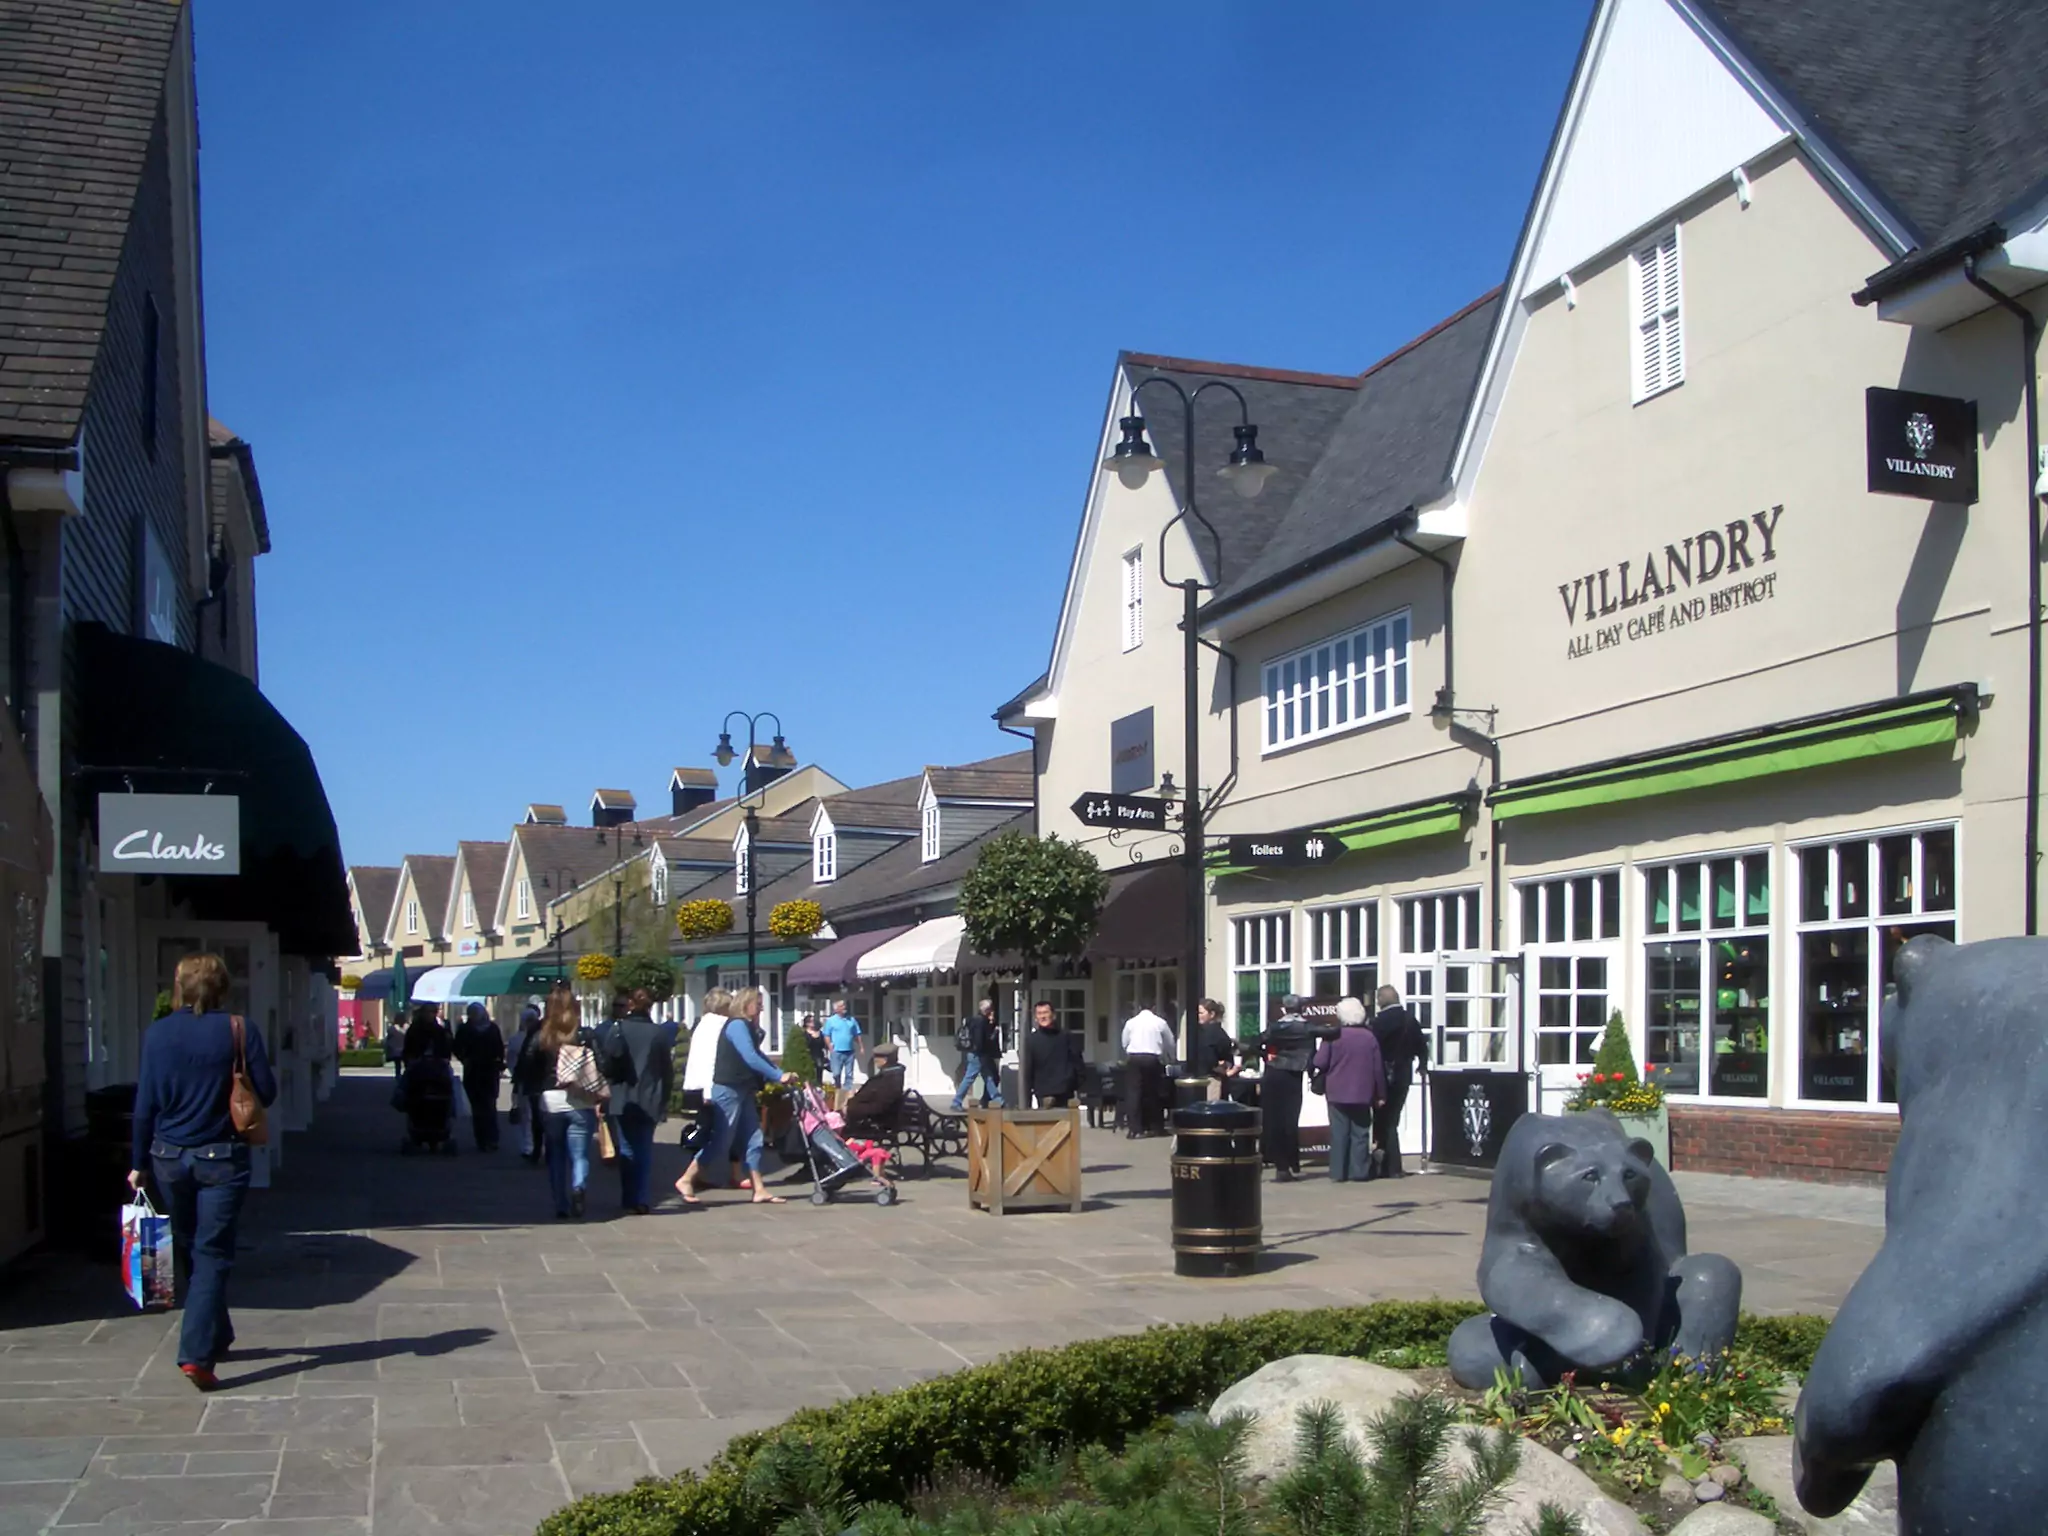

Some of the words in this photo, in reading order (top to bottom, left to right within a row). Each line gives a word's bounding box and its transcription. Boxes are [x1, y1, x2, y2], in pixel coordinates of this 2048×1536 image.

[1886, 458, 1956, 479] VILLANDRY
[1558, 504, 1784, 627] VILLANDRY
[1567, 634, 1593, 660] ALL
[1596, 622, 1623, 651] DAY
[1627, 605, 1665, 641] CAFÉ
[1669, 597, 1706, 630] AND
[1710, 572, 1777, 616] BISTROT
[1118, 805, 1135, 819] Play
[1135, 807, 1155, 819] Area
[113, 829, 225, 860] Clarks
[1250, 844, 1284, 856] Toilets
[1280, 1004, 1339, 1017] VLANDR
